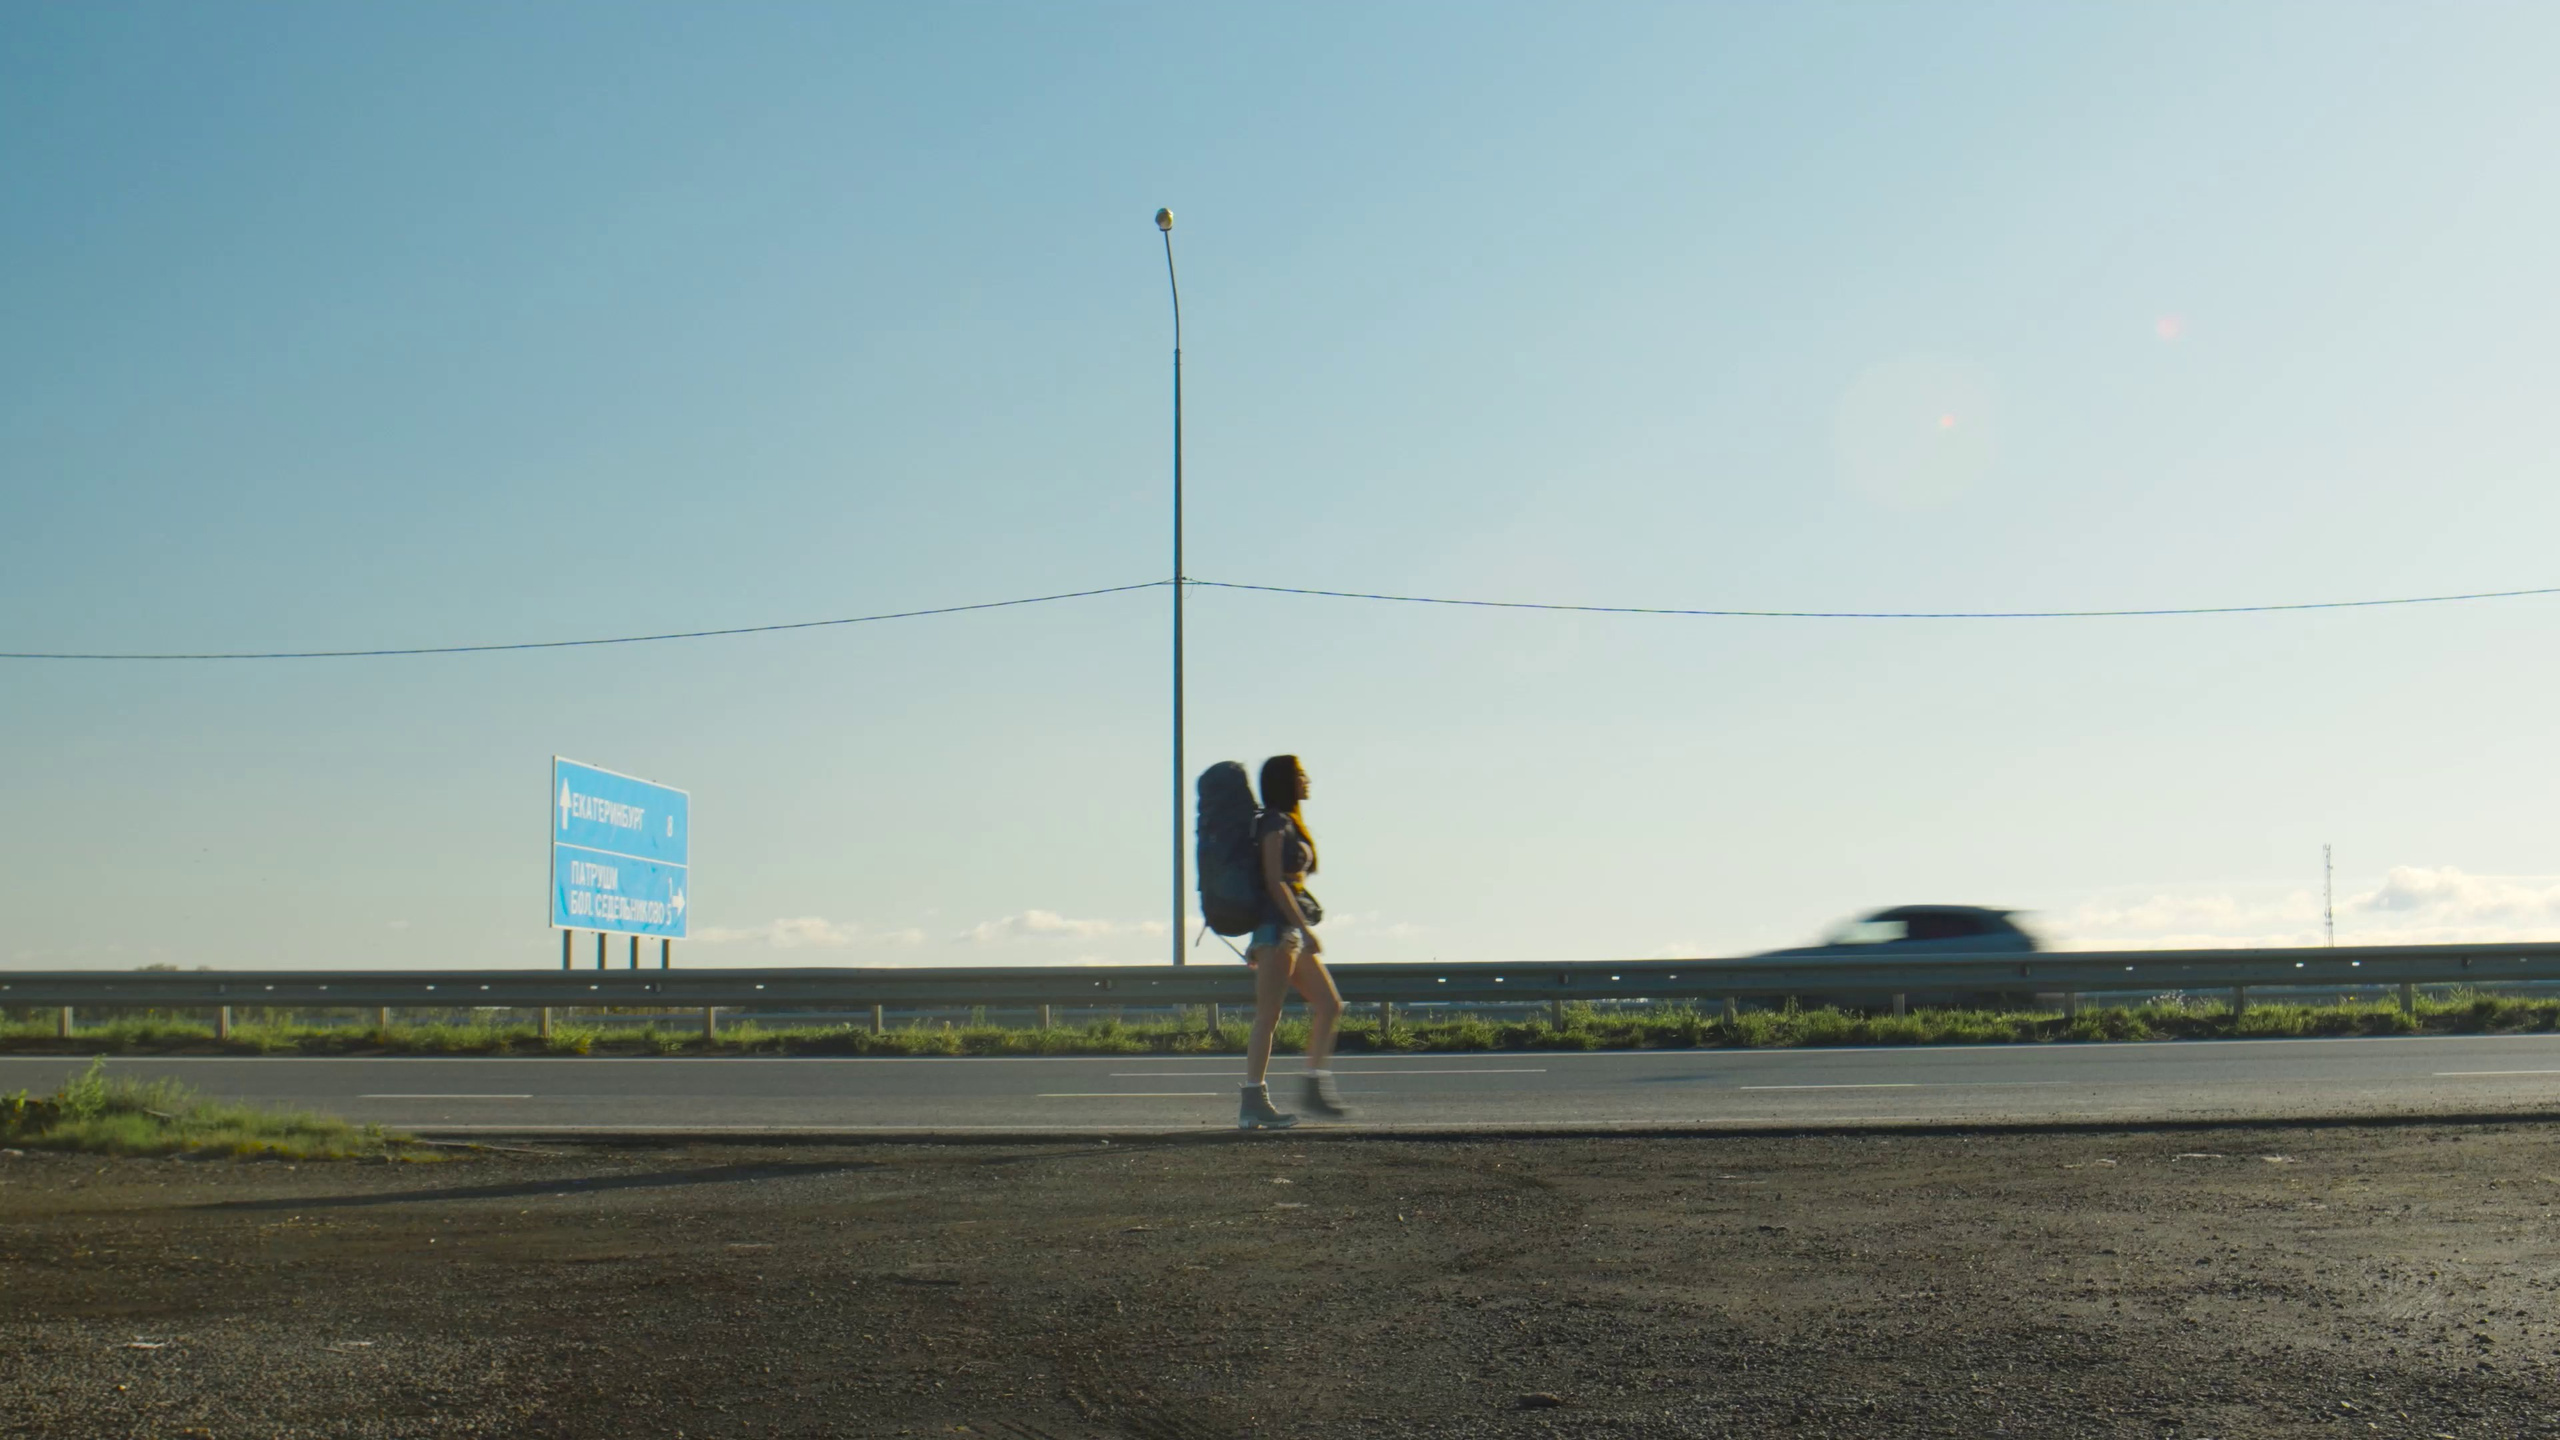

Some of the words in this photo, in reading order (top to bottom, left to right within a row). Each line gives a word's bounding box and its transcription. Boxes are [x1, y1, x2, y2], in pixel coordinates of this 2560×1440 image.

[572, 793, 645, 830] ЕКАТЕРИНБУРГ
[571, 861, 618, 889] ПАТРУШИ
[595, 894, 665, 924] СЕДЕЛЬНИКОВО
